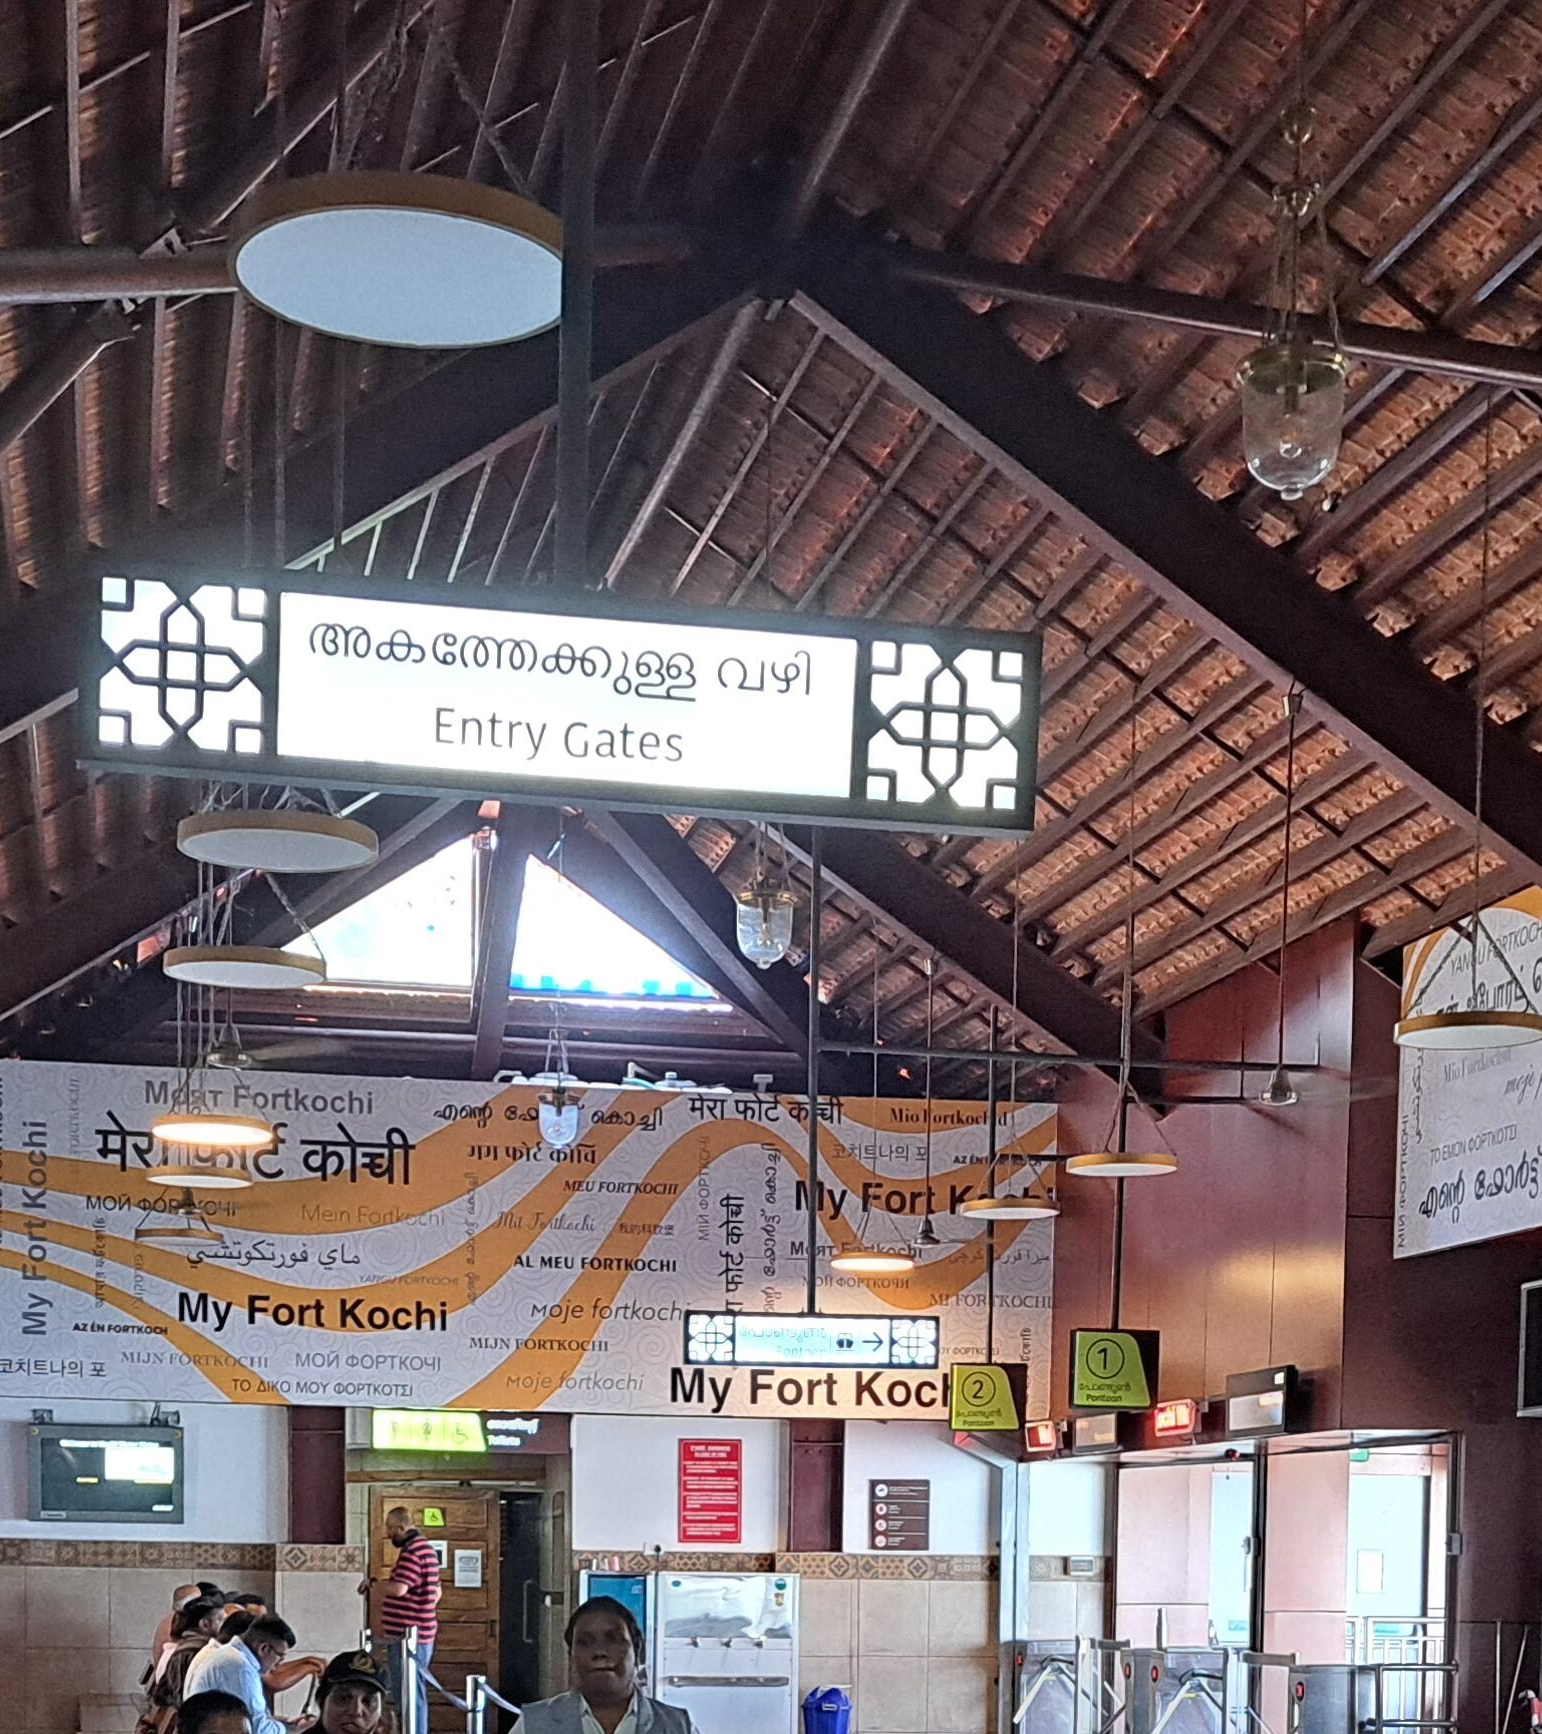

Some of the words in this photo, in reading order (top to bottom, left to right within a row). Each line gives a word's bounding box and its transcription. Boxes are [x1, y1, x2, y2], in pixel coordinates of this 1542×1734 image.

[308, 619, 697, 704] അകത്തേക്കുള്ള
[716, 649, 812, 698] വഴി
[433, 706, 548, 762] Entry
[561, 720, 685, 764] Gates
[234, 1085, 373, 1115] Fortkochi
[688, 1094, 725, 1121] मेरा
[734, 1094, 781, 1123] फोर्ट
[433, 1103, 493, 1128] എന്റെ
[890, 1107, 919, 1123] Mio
[832, 1143, 909, 1162] 코치트나의
[22, 1121, 47, 1210] Kochi
[563, 1180, 595, 1193] MEU
[598, 1181, 679, 1196] FORTKOCHI
[85, 1195, 131, 1211] МОЙ
[795, 1181, 847, 1220] My
[862, 1182, 936, 1216] Fort
[301, 1206, 351, 1225] Mein
[357, 1207, 446, 1227] Fortkochi
[527, 1212, 597, 1233] Fortkochi
[22, 1219, 47, 1282] Fort
[513, 1254, 535, 1269] AL
[540, 1255, 575, 1271] MEU
[580, 1256, 678, 1273] FORTKOCHI
[717, 1249, 745, 1293] फोर्ट
[22, 1293, 54, 1336] My
[178, 1291, 233, 1332] My
[247, 1295, 324, 1329] Fort
[340, 1299, 448, 1332] Kochi
[591, 1299, 690, 1322] fortkochi
[72, 1322, 90, 1333] AZ
[469, 1336, 510, 1351] MIJN
[515, 1338, 609, 1353] FORTKOCHI
[120, 1350, 164, 1366] MIJN
[168, 1353, 269, 1369] FORTKOCHI
[294, 1352, 340, 1369] МОЙ
[345, 1354, 442, 1373] ФОРТКОЧІ
[1097, 1347, 1109, 1371] 1
[90, 1362, 107, 1379] 포
[556, 1370, 645, 1391] fortkochi
[669, 1366, 733, 1414] My
[749, 1369, 838, 1409] Fort
[972, 1379, 985, 1400] 2
